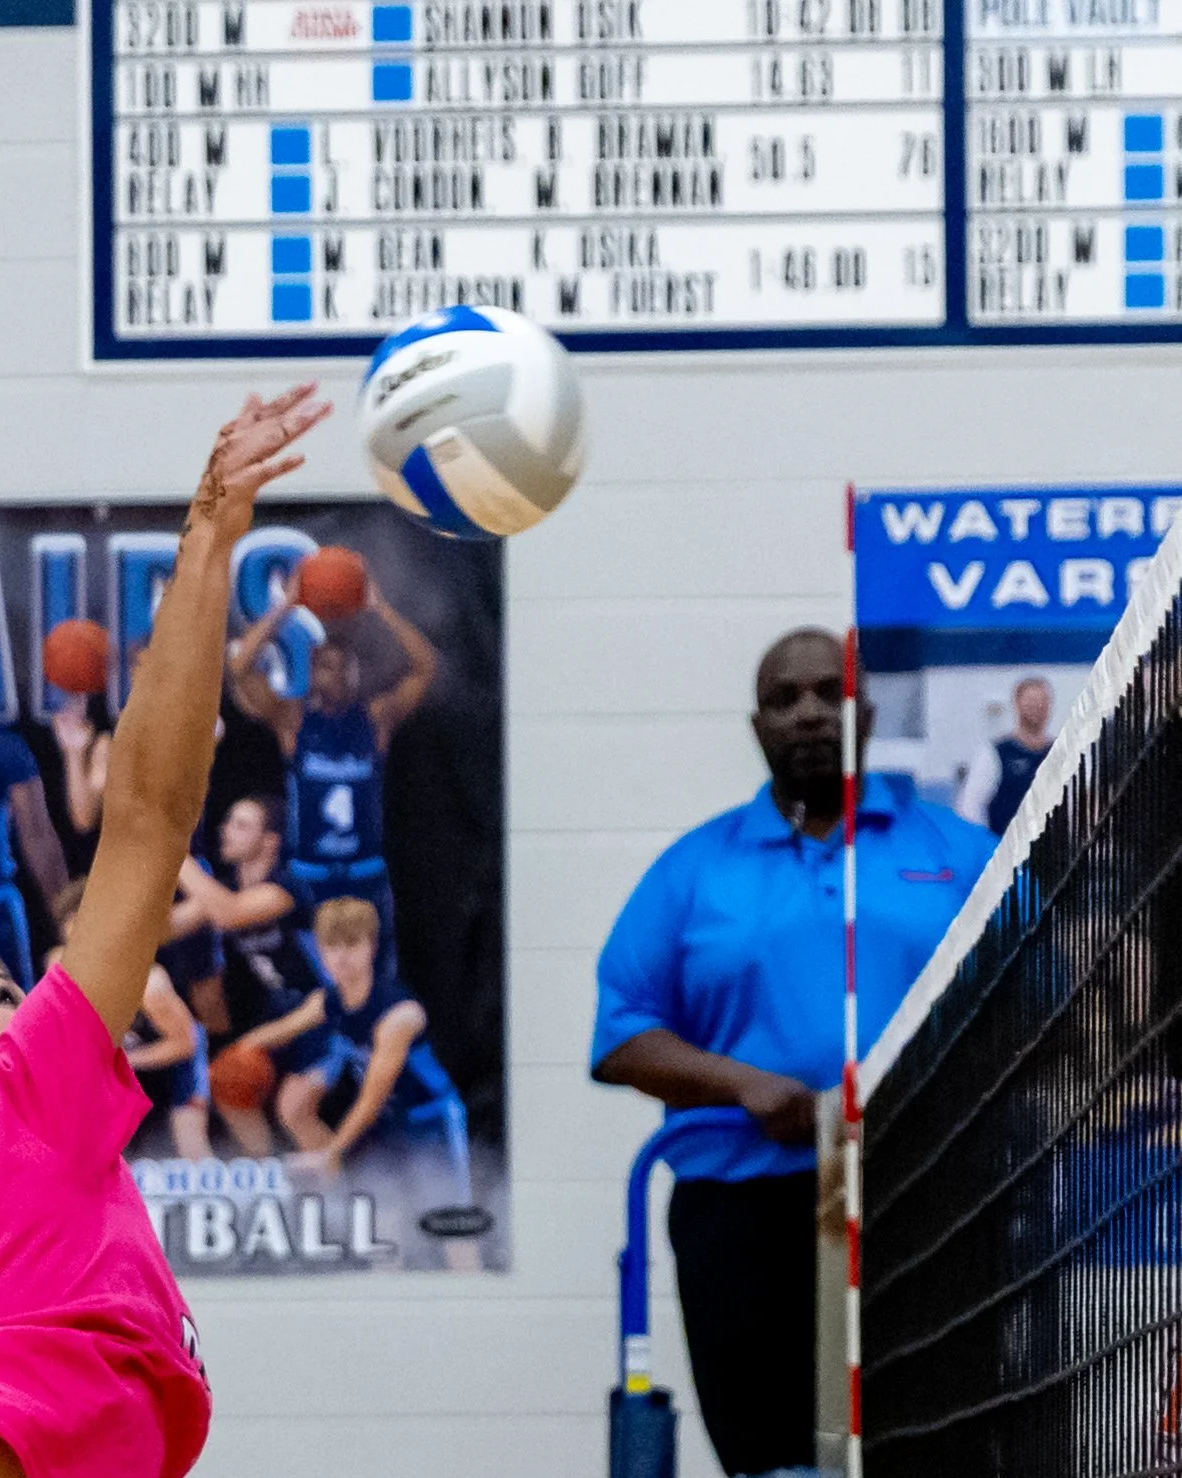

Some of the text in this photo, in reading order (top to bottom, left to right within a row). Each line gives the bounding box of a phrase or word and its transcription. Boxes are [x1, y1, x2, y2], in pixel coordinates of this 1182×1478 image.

[423, 0, 555, 42] SHANNON
[425, 54, 554, 103] ALLYSON
[127, 167, 219, 216] RELAY
[590, 161, 725, 208] BRENNAN
[978, 158, 1069, 205] RELAY
[126, 275, 218, 326] RELAY
[978, 266, 1069, 315] RELAY
